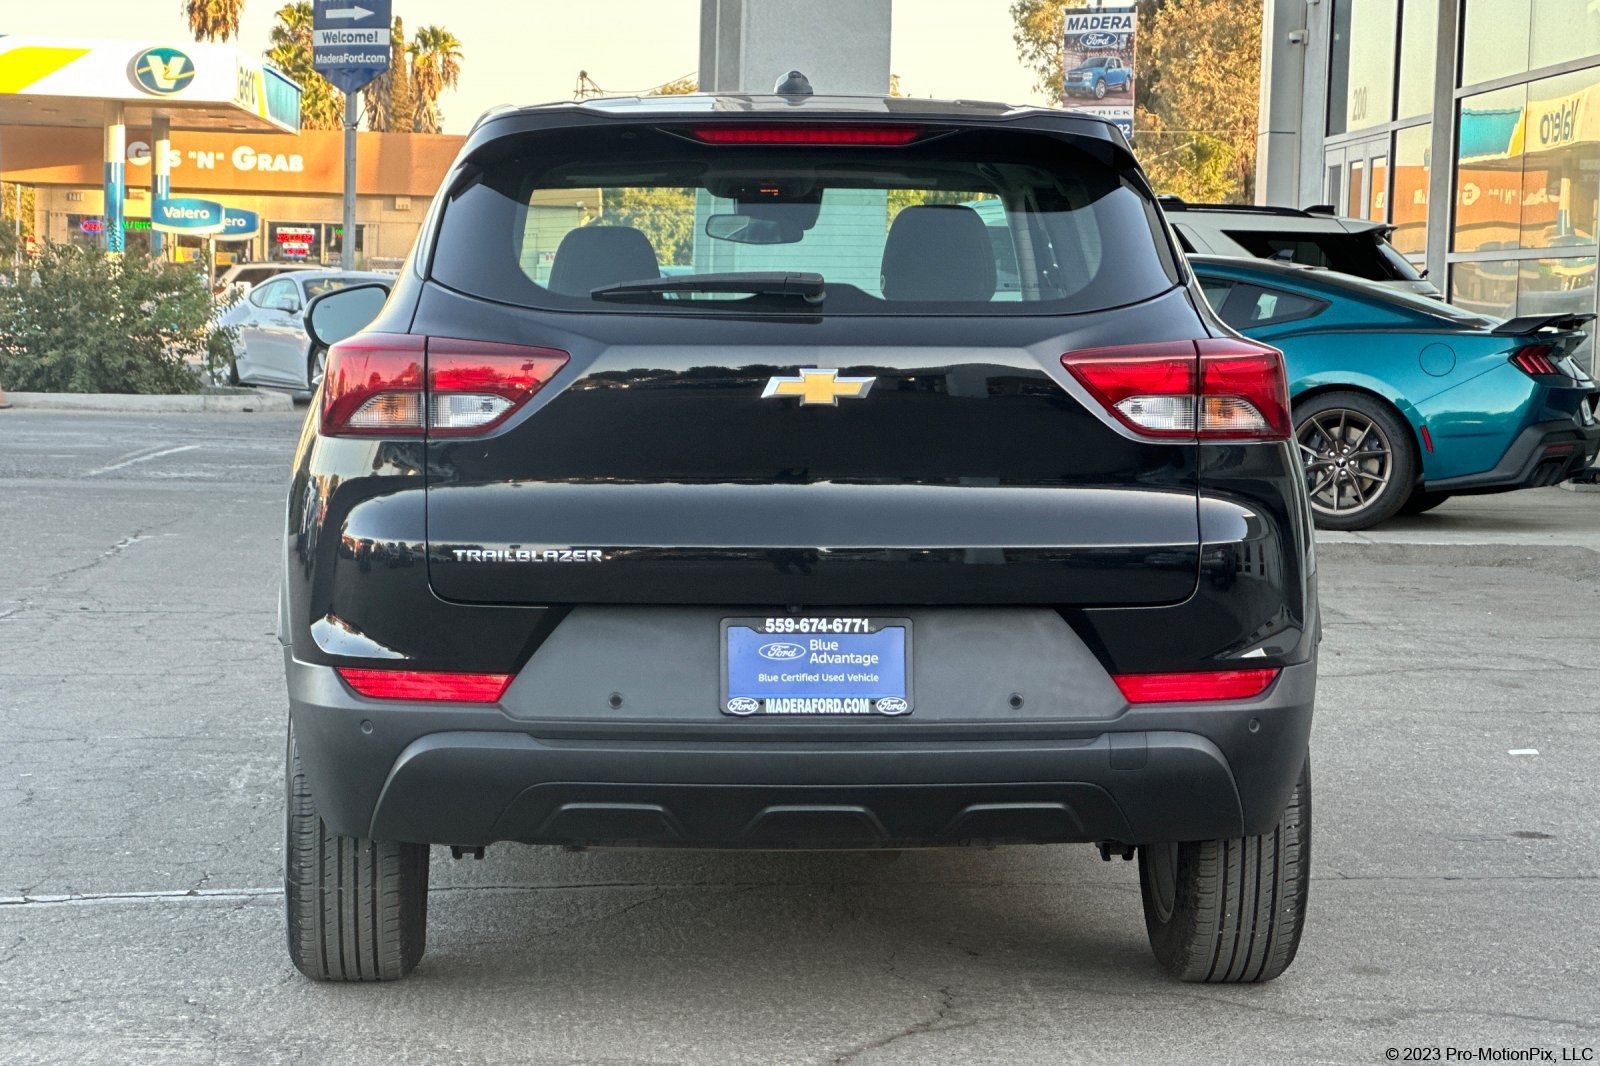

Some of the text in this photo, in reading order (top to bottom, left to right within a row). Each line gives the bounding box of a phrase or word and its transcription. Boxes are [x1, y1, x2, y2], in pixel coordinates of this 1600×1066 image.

[1067, 16, 1132, 31] MADERA
[322, 31, 378, 44] Welcome!
[1085, 33, 1110, 46] Ford
[315, 52, 386, 64] MaderaFord.com
[1352, 86, 1368, 121] 200
[231, 145, 304, 172] GRAB
[163, 206, 210, 220] Valero
[452, 549, 602, 562] TRAILBLAZER
[765, 618, 869, 633] 559-674-6771
[766, 644, 797, 657] Ford
[809, 639, 839, 651] Blue
[809, 652, 879, 666] Advantage
[758, 673, 879, 682] Blue Certified Used Vehicle
[729, 699, 757, 712] Ford
[766, 698, 869, 713] MADERAFORD.COM
[878, 699, 907, 712] Ford
